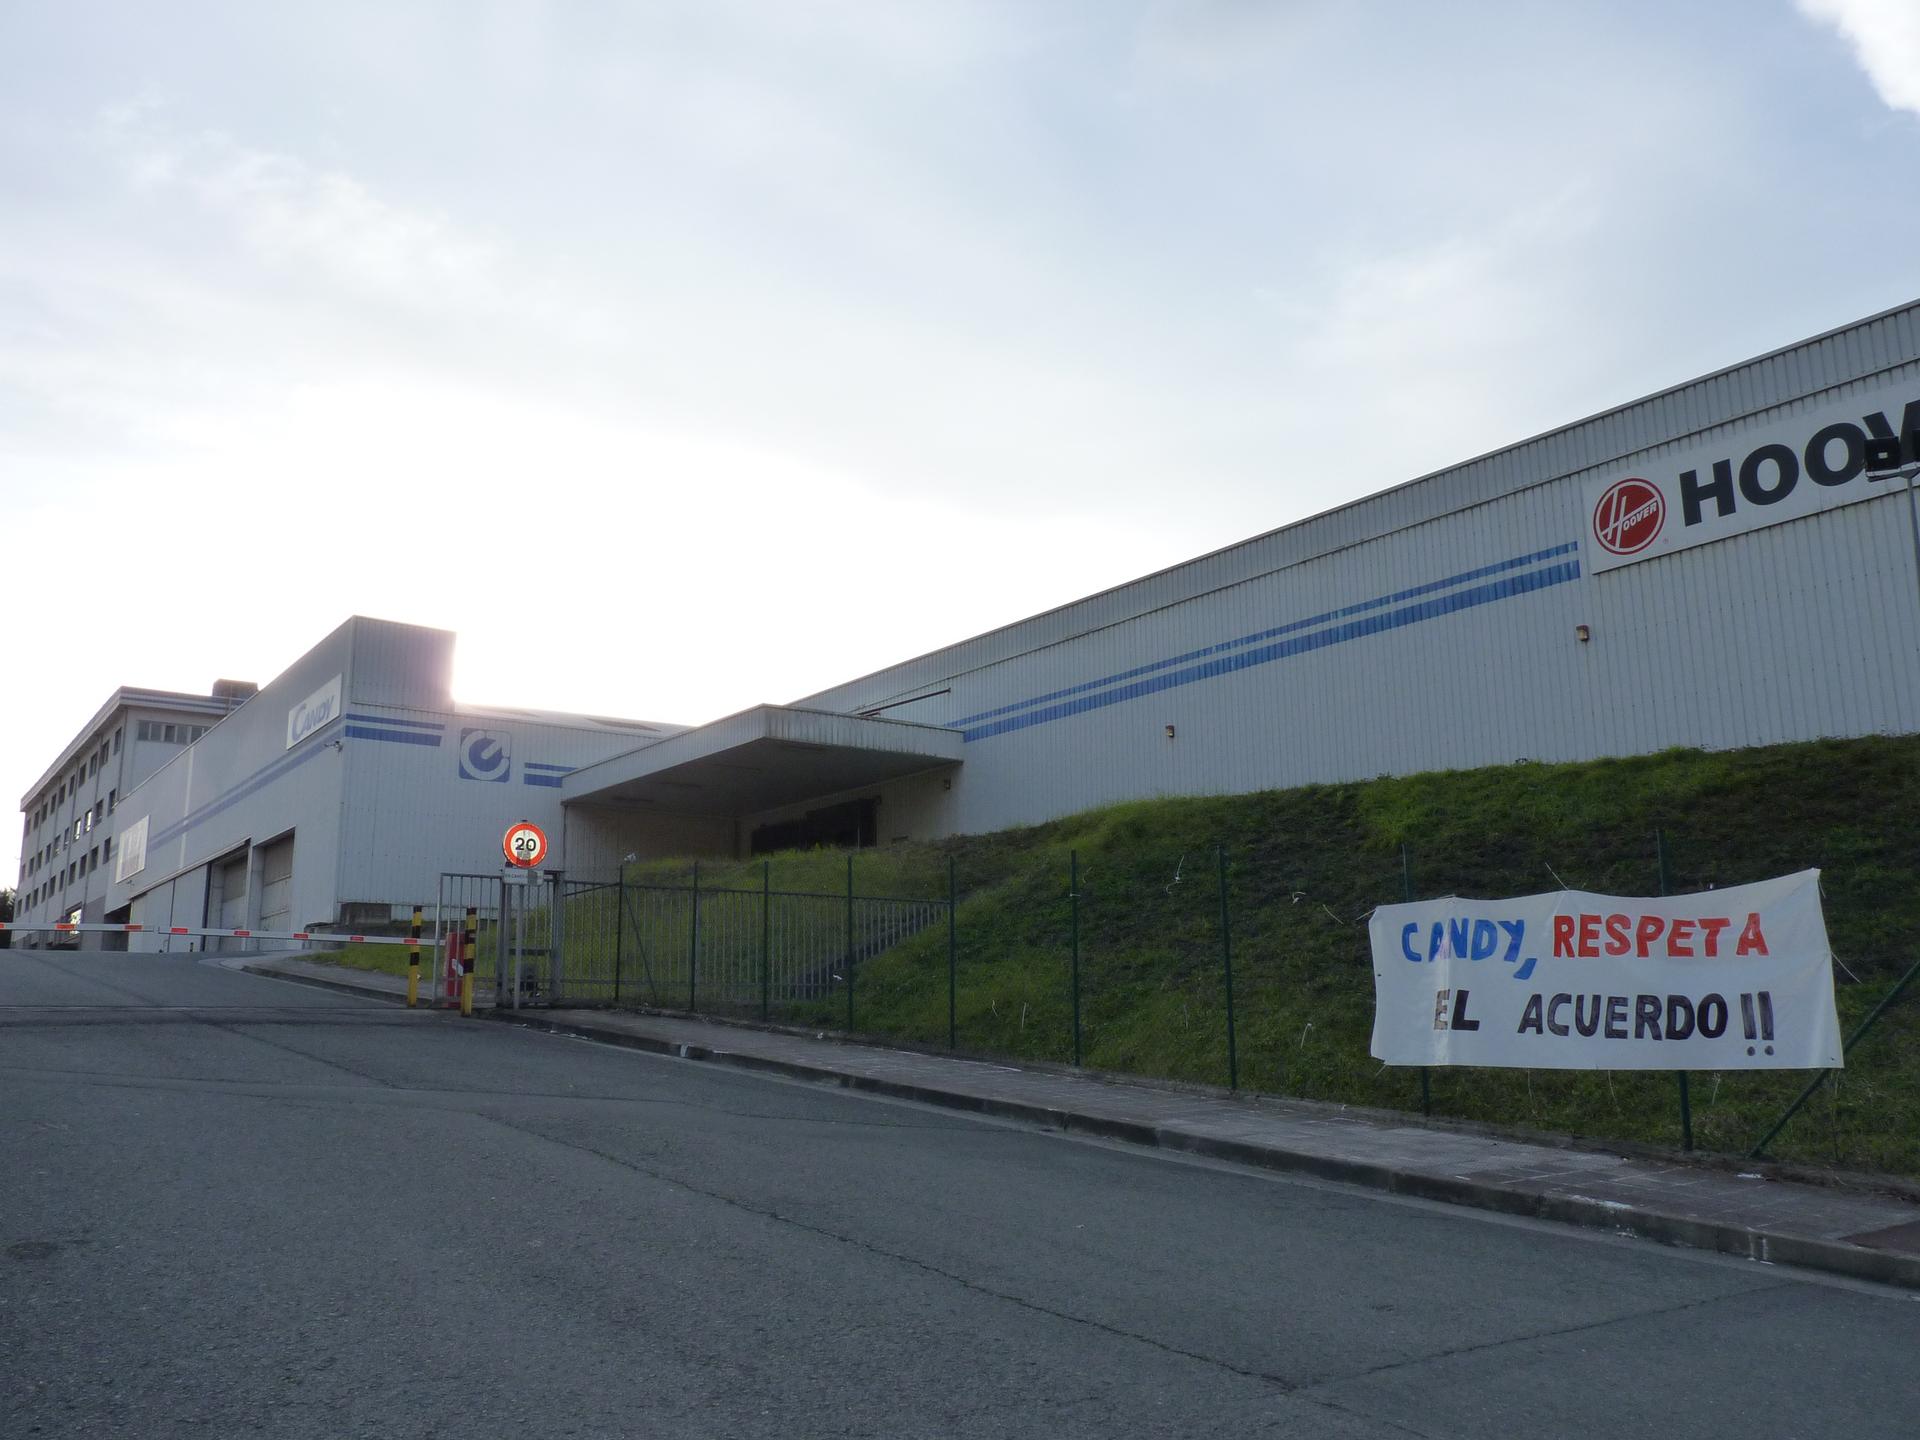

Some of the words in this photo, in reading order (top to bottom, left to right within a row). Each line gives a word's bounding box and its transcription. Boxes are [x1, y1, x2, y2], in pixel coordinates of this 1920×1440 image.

[515, 837, 537, 852] 20
[1401, 917, 1538, 980] CANDY,
[1553, 912, 1770, 959] RESPETA
[1432, 988, 1481, 1033] EL
